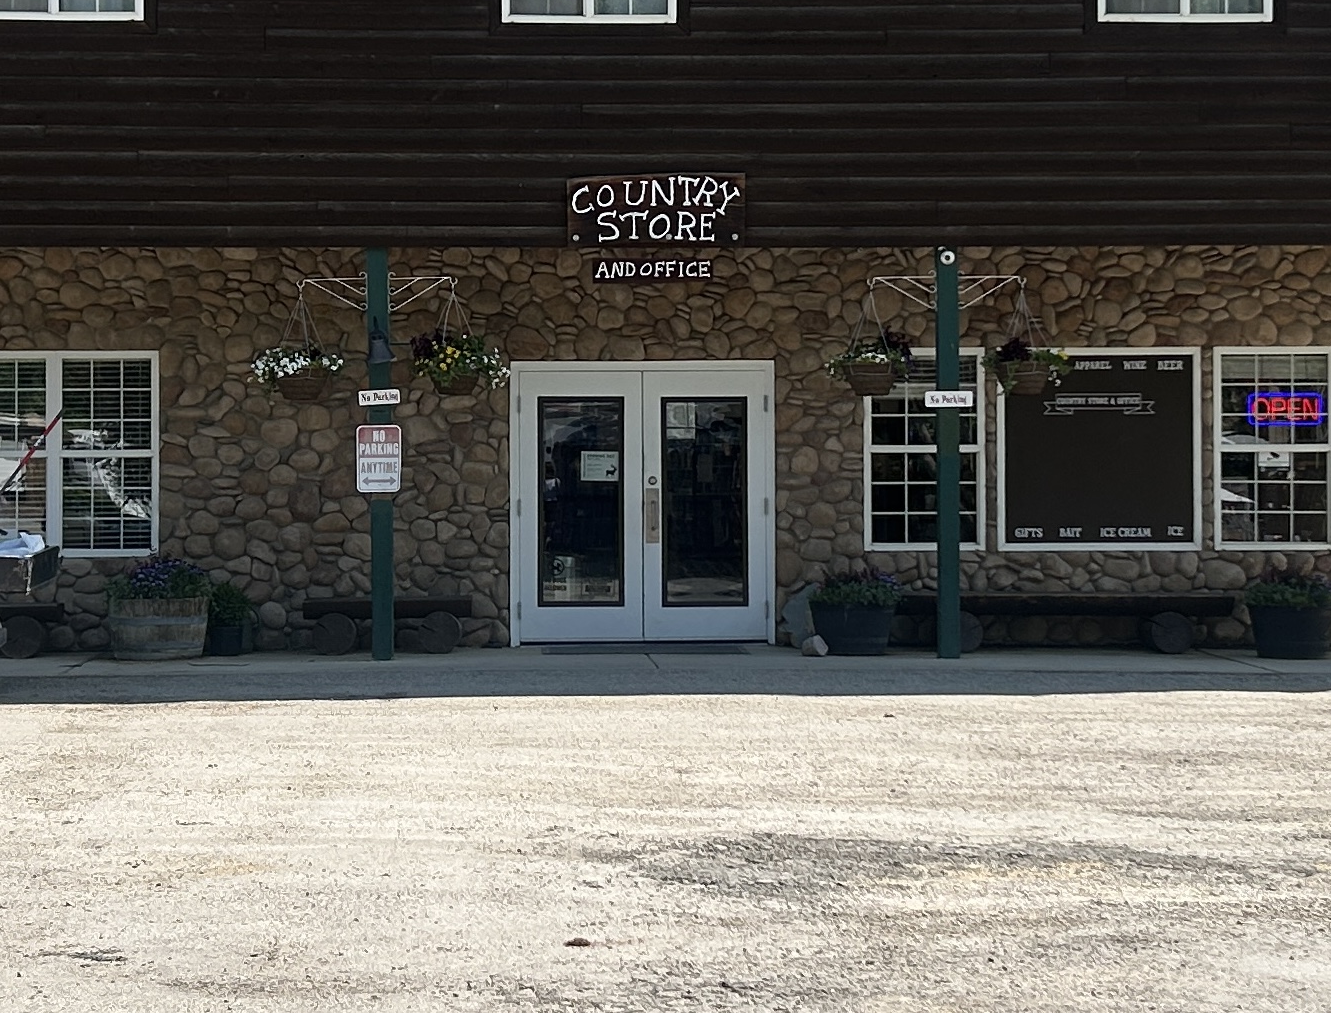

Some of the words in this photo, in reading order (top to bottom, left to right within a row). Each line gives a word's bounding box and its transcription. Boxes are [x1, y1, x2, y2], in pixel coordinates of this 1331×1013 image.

[571, 175, 741, 216] COUNTRY
[597, 210, 716, 243] STORE
[594, 261, 637, 279] AND
[639, 260, 711, 278] OFFICE
[1157, 360, 1184, 371] BEER
[1251, 397, 1319, 421] OPEN
[372, 430, 385, 443] NO
[359, 443, 399, 455] PARKING
[360, 462, 398, 474] ANYTIME
[1100, 527, 1117, 538] ICE
[1117, 527, 1152, 538] CREAM
[1168, 526, 1184, 537] ICE
